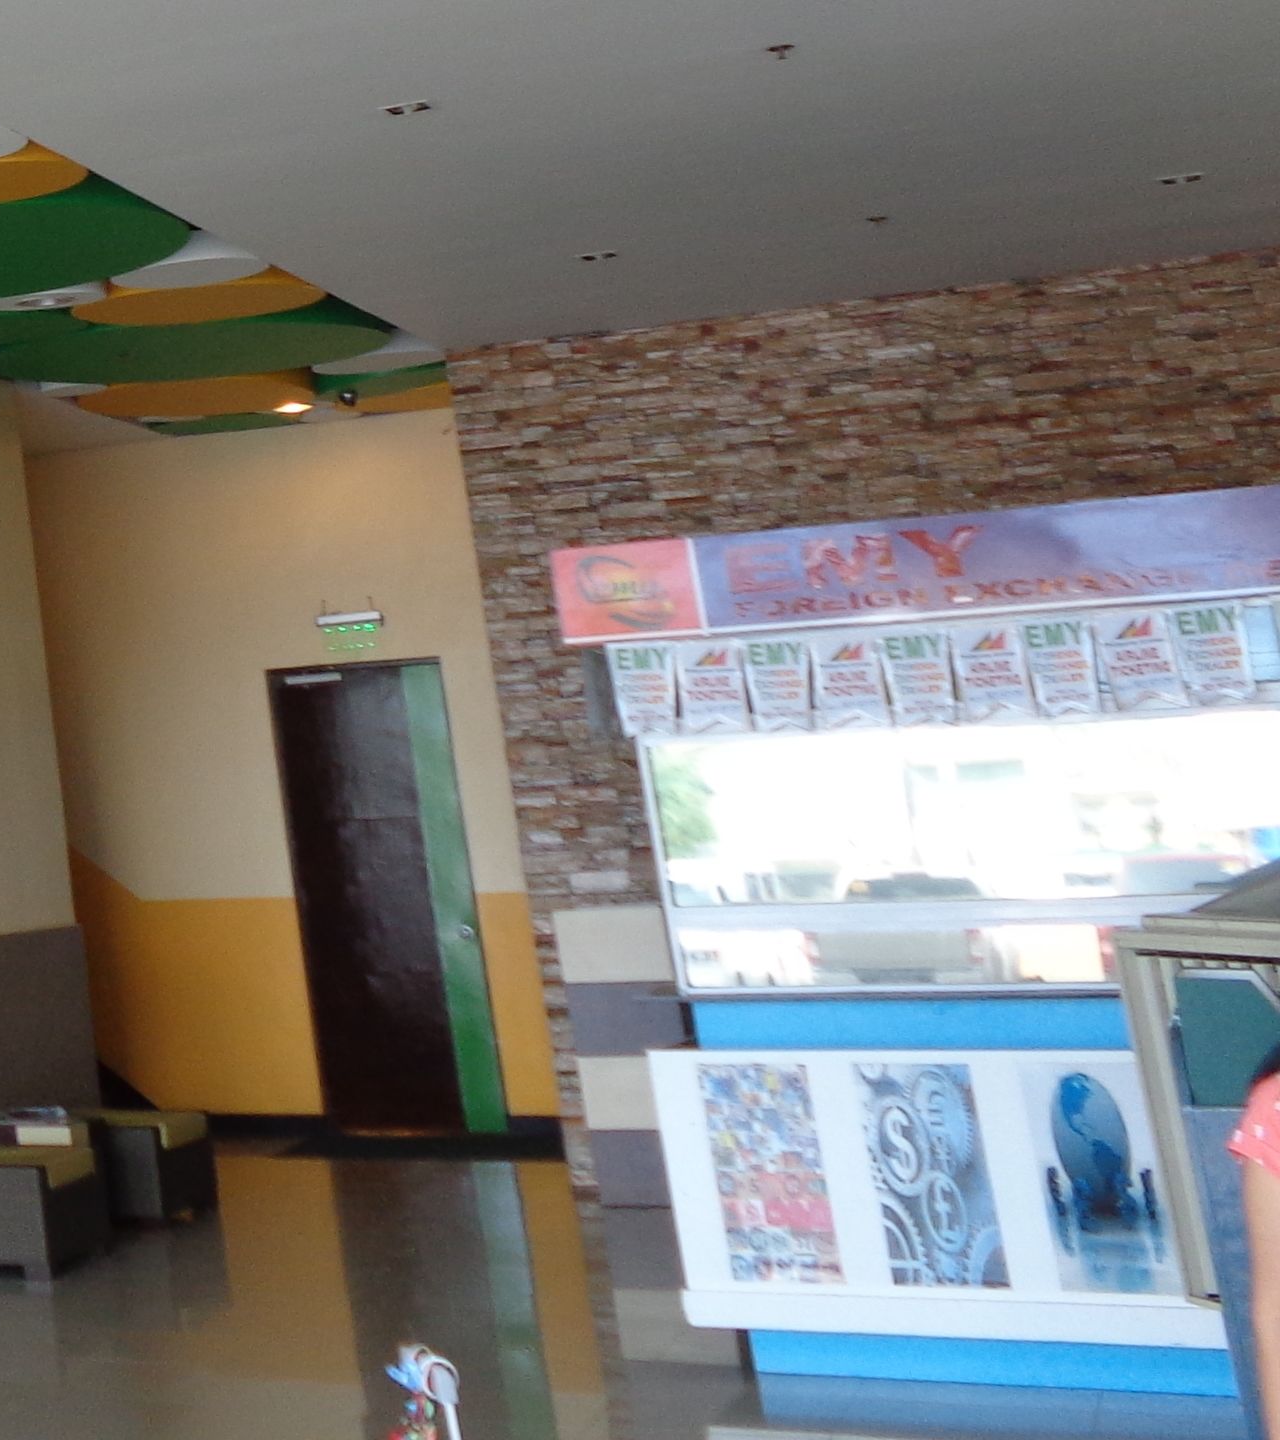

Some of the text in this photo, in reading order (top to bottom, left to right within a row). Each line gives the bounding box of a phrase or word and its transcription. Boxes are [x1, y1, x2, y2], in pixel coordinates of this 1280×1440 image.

[725, 524, 984, 595] EMY
[734, 584, 929, 618] FOREIGN
[1025, 621, 1082, 648] EMY
[1176, 606, 1236, 636] EMY
[617, 646, 669, 671] EMY
[748, 642, 803, 666] EMY
[884, 633, 943, 660] EMY
